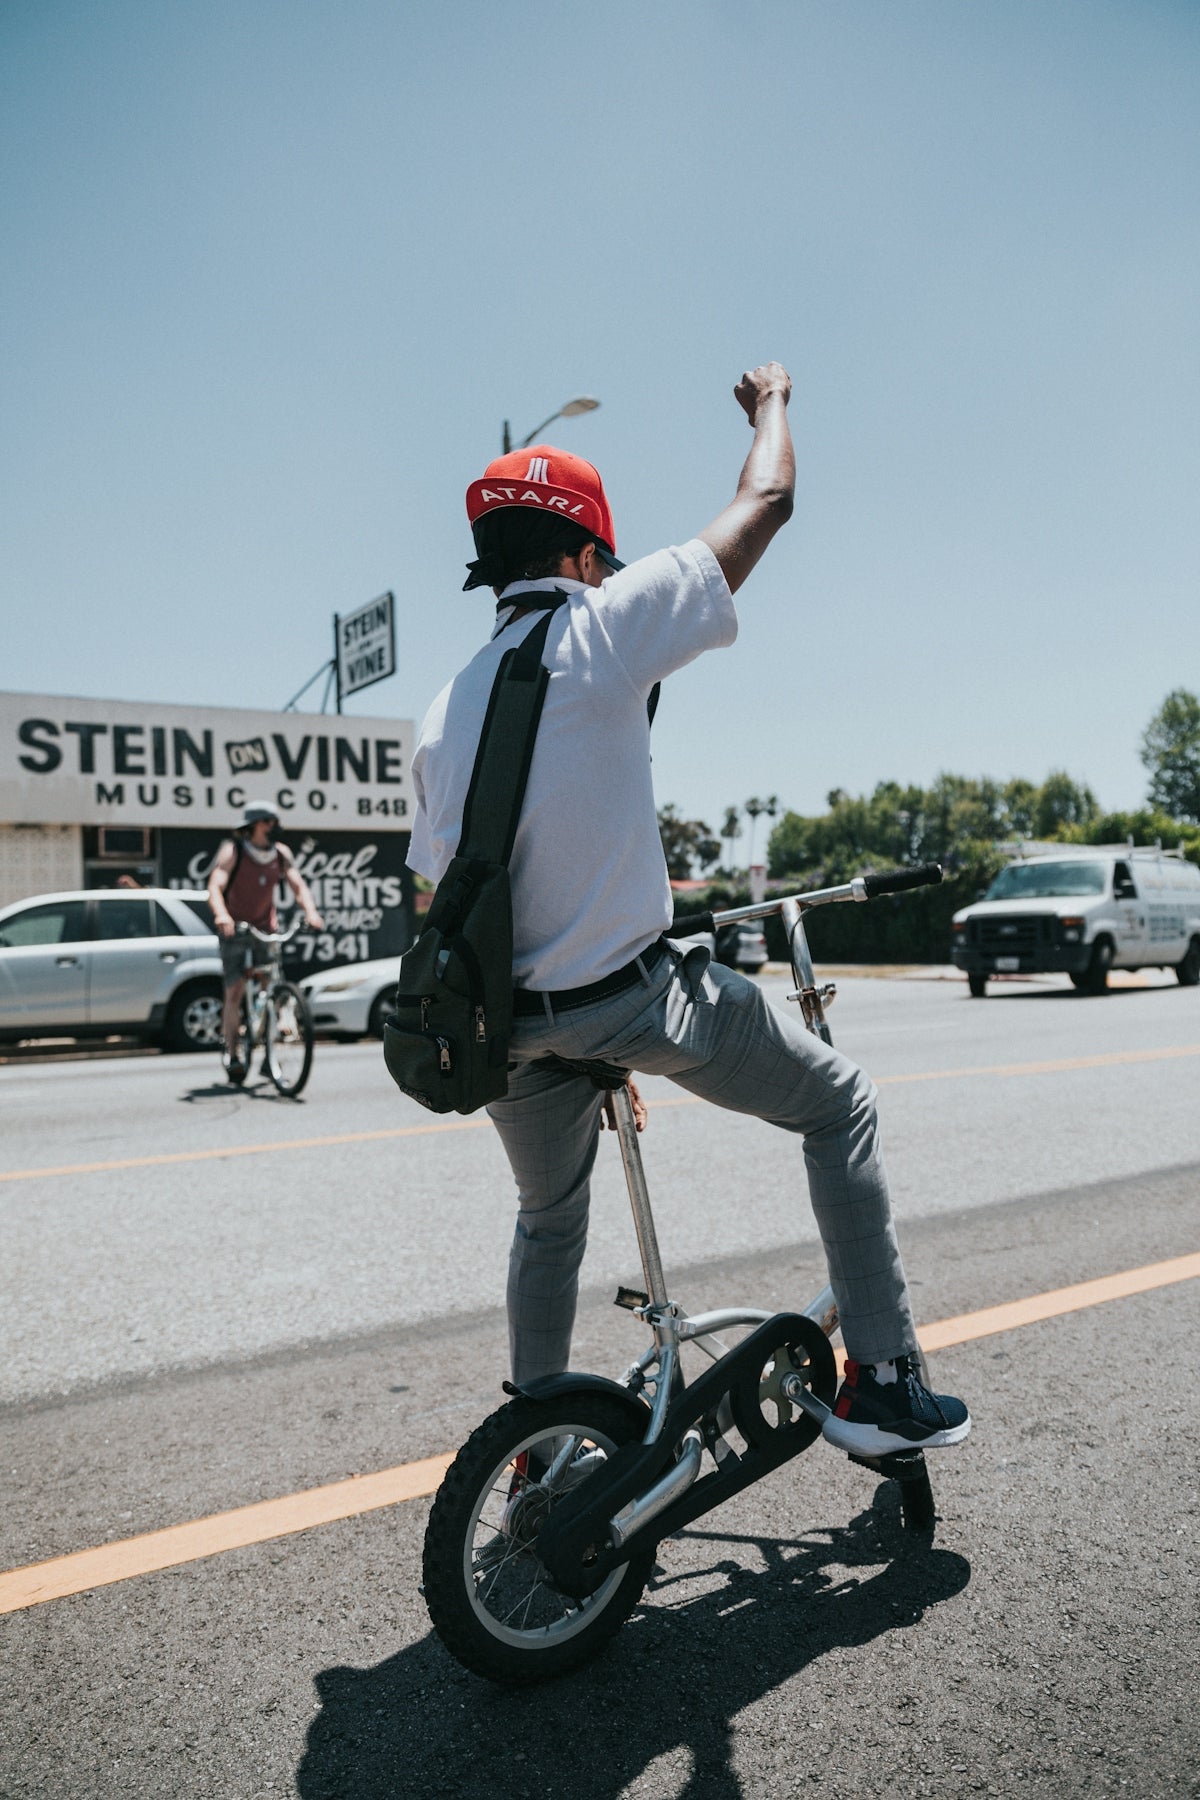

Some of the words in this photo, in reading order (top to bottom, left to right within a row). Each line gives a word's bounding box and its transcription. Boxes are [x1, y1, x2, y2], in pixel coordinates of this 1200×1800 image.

[480, 487, 585, 516] ATARI
[344, 601, 388, 648] STEIN
[347, 646, 385, 684] VINE
[18, 718, 214, 778] STEIN
[229, 741, 266, 769] ON
[271, 732, 402, 784] VINE
[95, 782, 247, 810] MUSIC
[276, 788, 339, 811] CO.
[357, 798, 407, 817] 848
